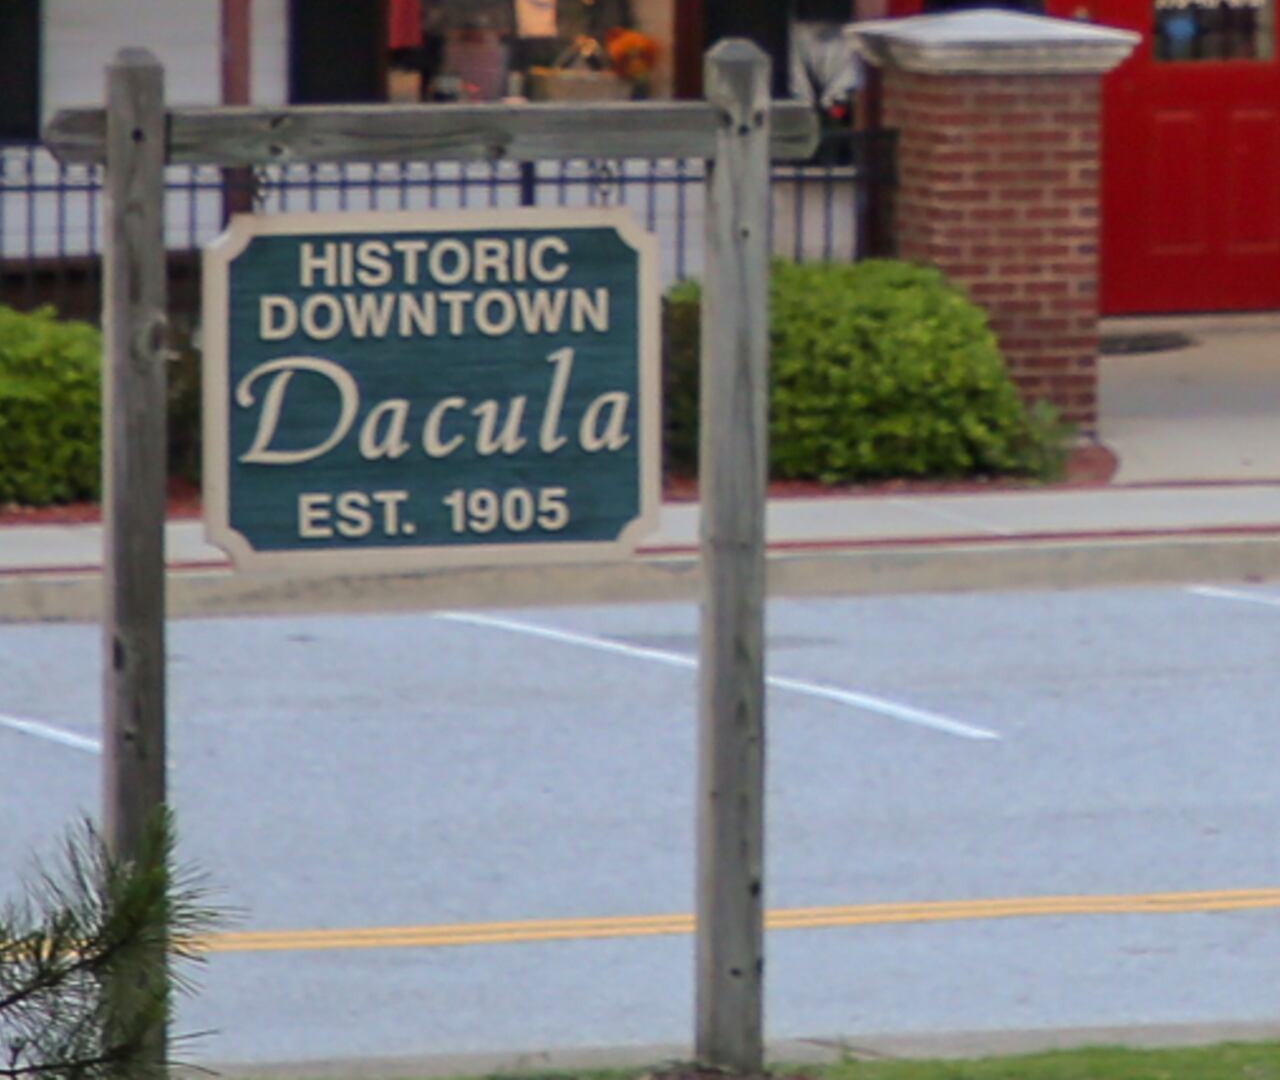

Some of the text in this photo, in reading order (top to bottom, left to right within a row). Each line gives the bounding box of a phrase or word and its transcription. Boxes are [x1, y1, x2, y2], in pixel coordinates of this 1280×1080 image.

[299, 236, 570, 288] HISTORIC
[258, 287, 610, 340] DOWNTOWN
[236, 347, 631, 464] Dacula
[298, 486, 570, 538] EST. 1905
